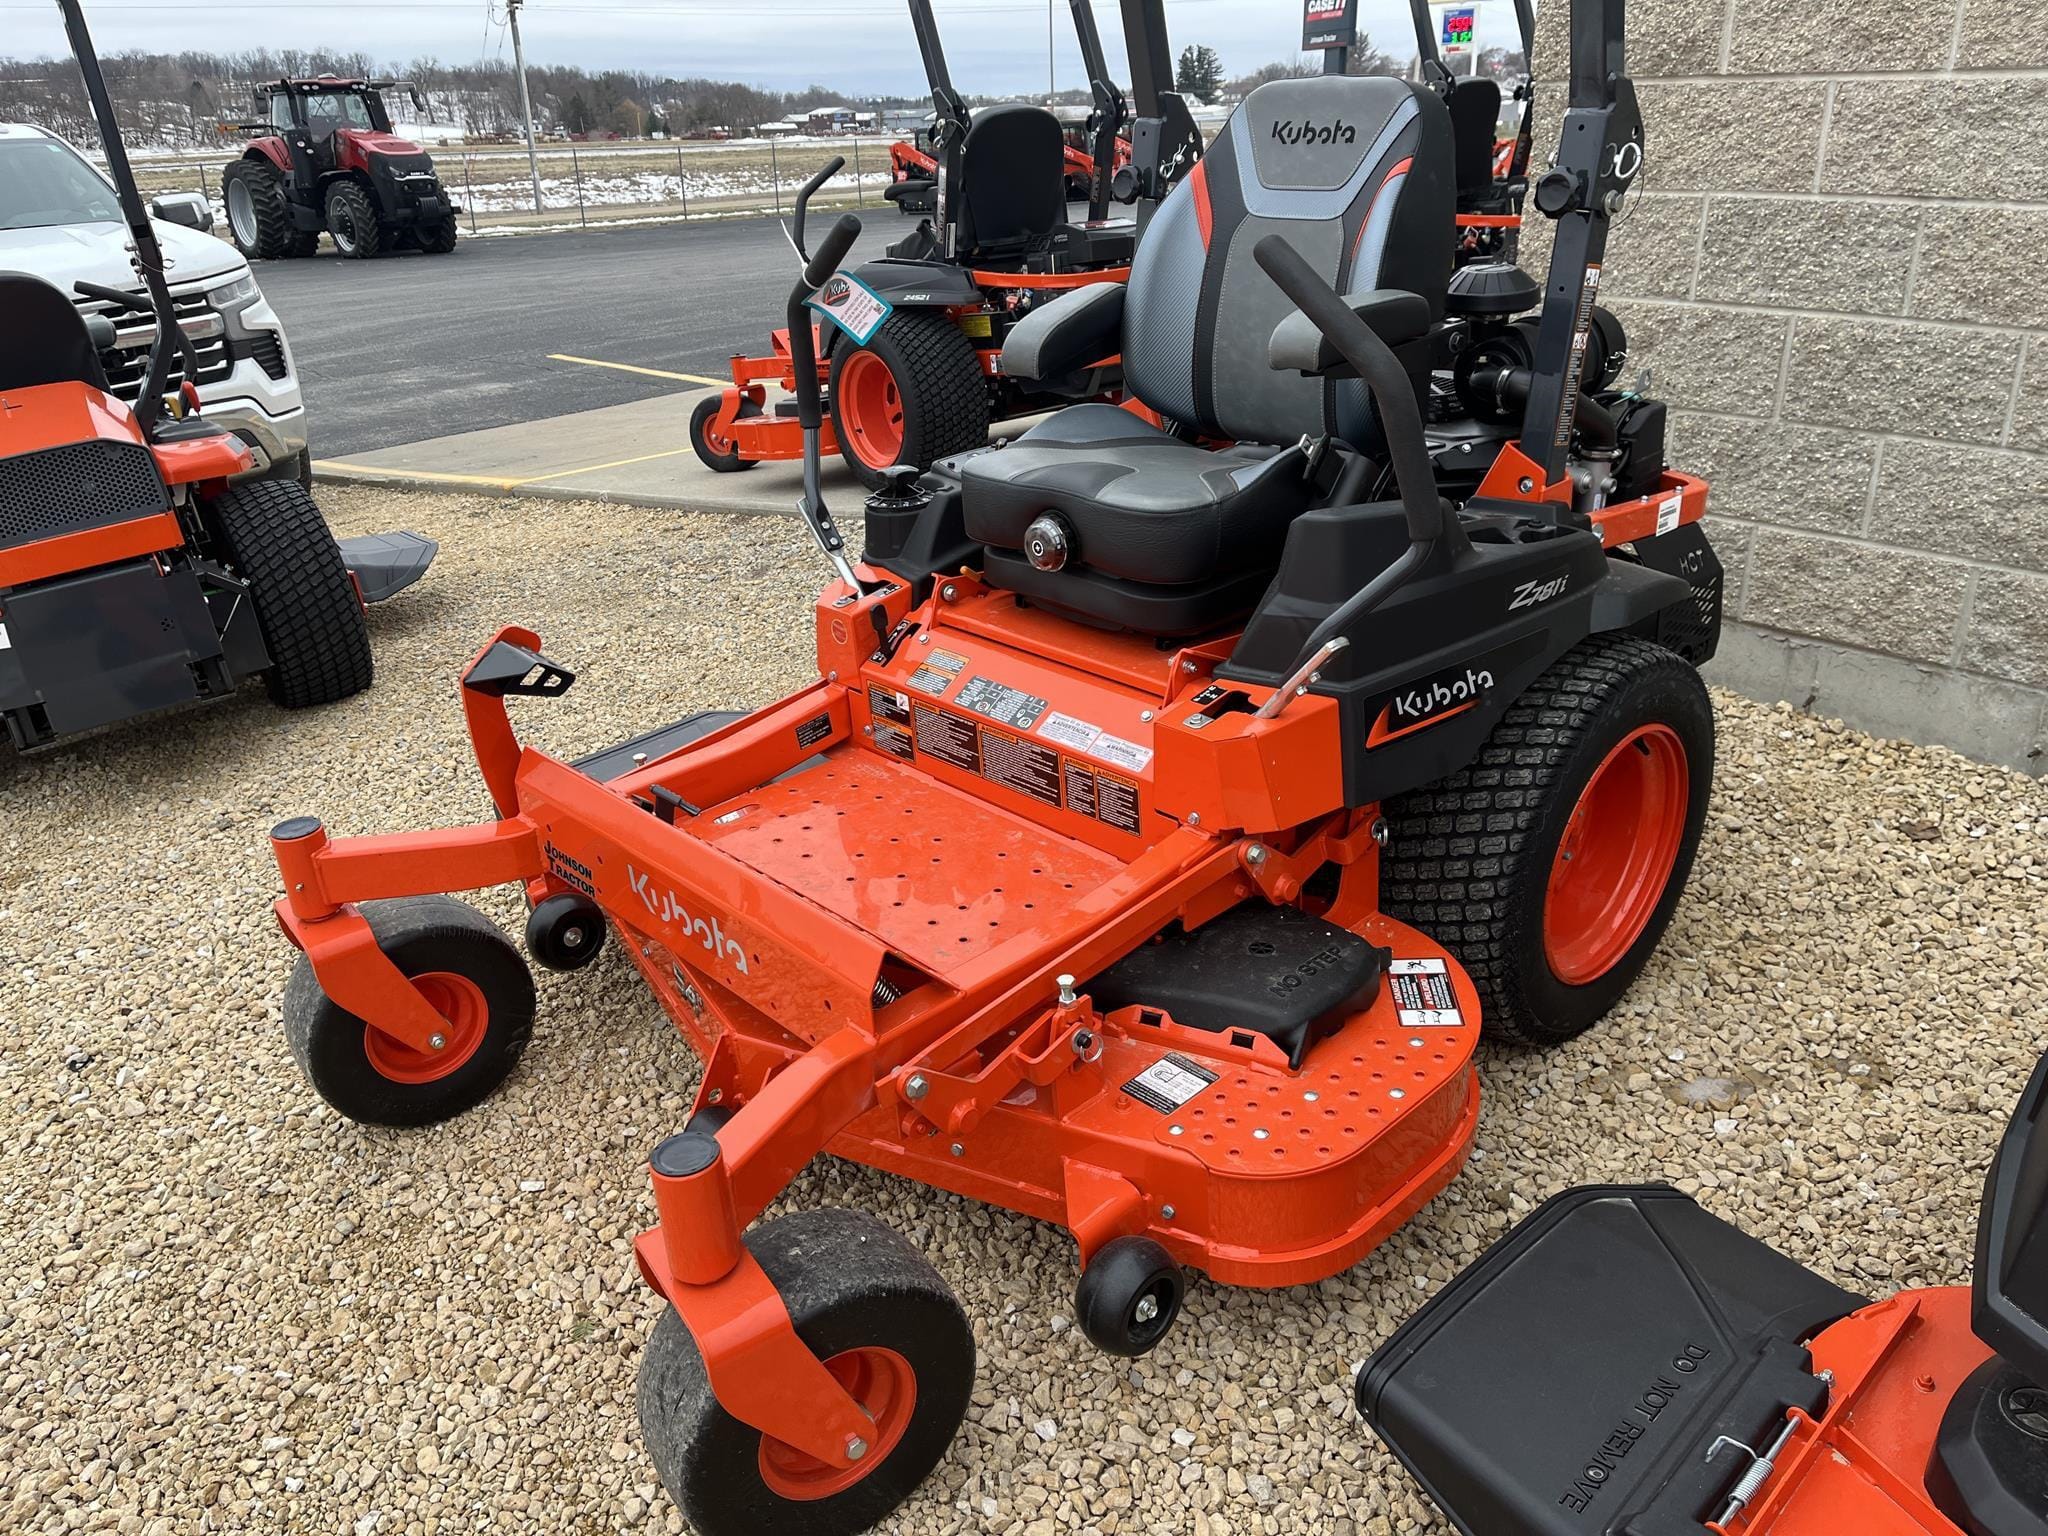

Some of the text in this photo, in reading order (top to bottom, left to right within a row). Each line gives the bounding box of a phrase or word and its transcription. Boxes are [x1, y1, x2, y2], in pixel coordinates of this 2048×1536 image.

[1272, 119, 1356, 145] Kubota
[1395, 667, 1495, 717] Kubota
[543, 840, 592, 880] JOHNSON
[547, 855, 596, 897] TRACTOR
[626, 863, 749, 976] Kubota
[1268, 945, 1342, 998] NO STEP
[1558, 1341, 1711, 1514] DO NOT REMOVE
